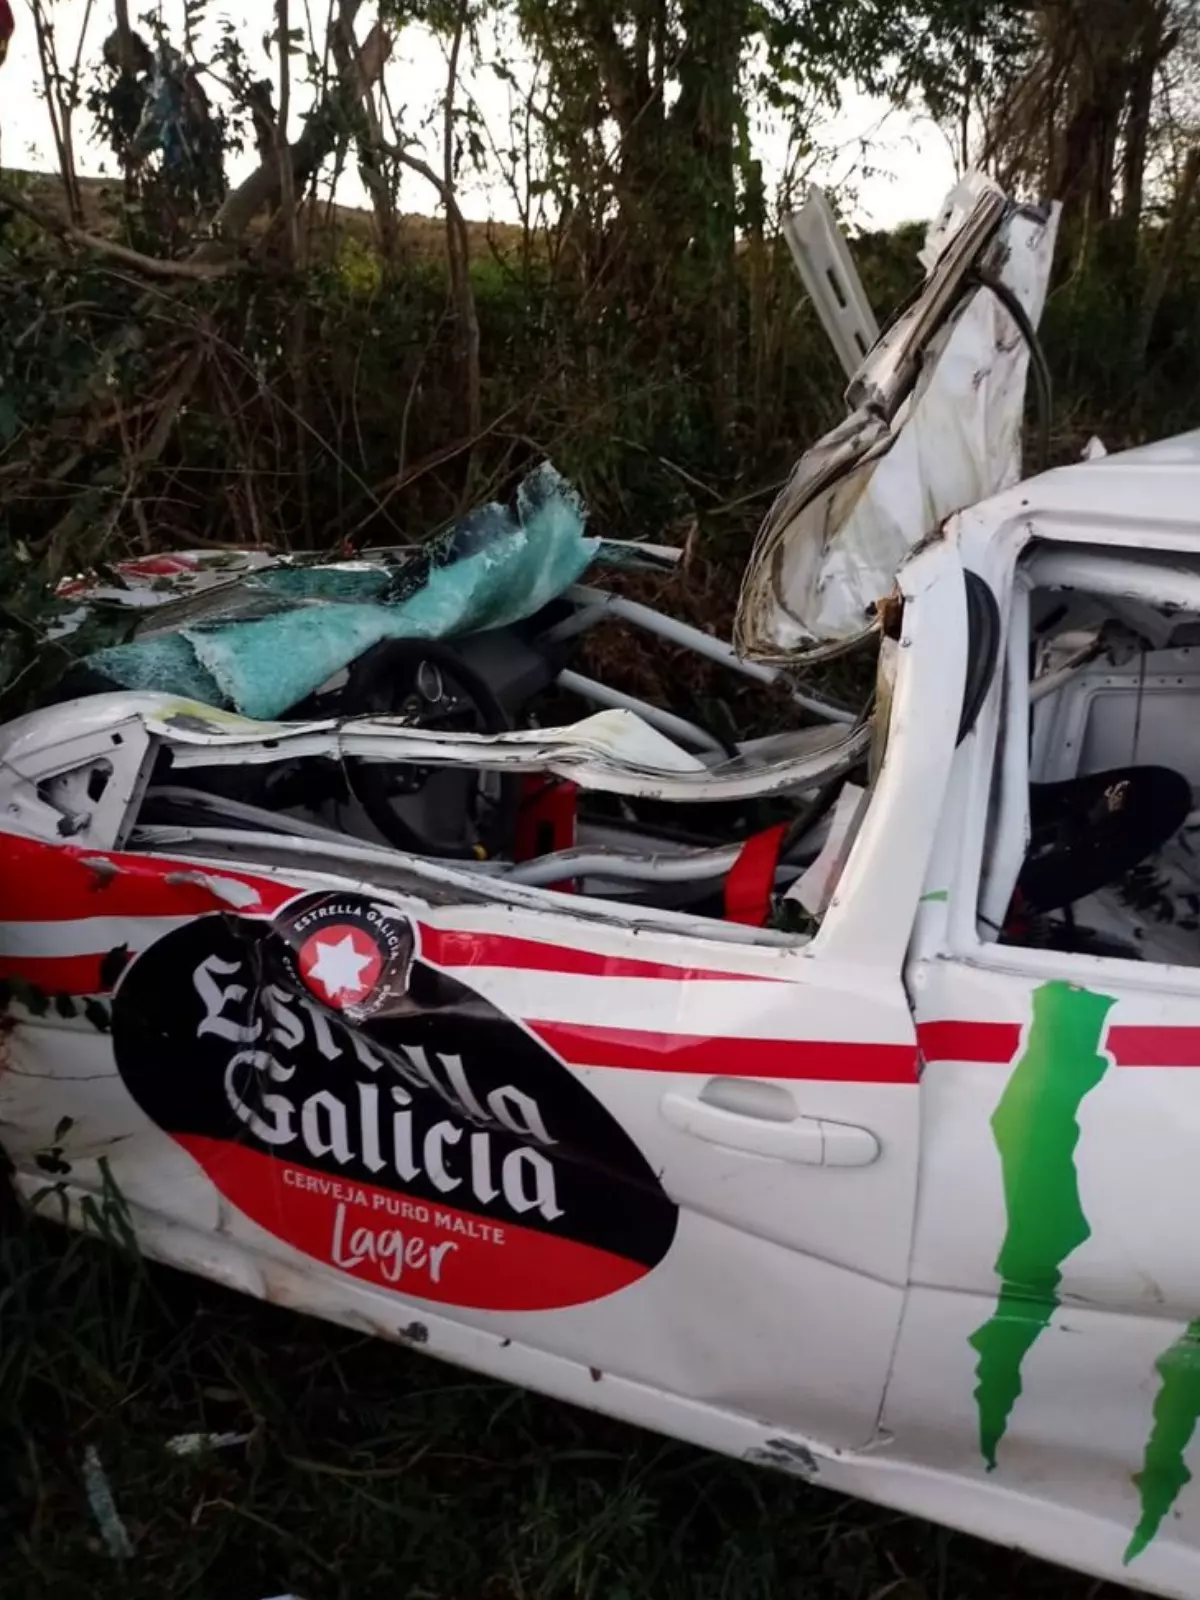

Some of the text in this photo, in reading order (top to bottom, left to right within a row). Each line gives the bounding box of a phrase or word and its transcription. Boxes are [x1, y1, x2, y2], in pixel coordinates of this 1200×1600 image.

[293, 903, 401, 961] ESTRELLA GALICIA
[224, 1049, 566, 1222] Galicia
[282, 1168, 505, 1245] CERVEJA PURO MALTE
[329, 1204, 459, 1284] Lager
